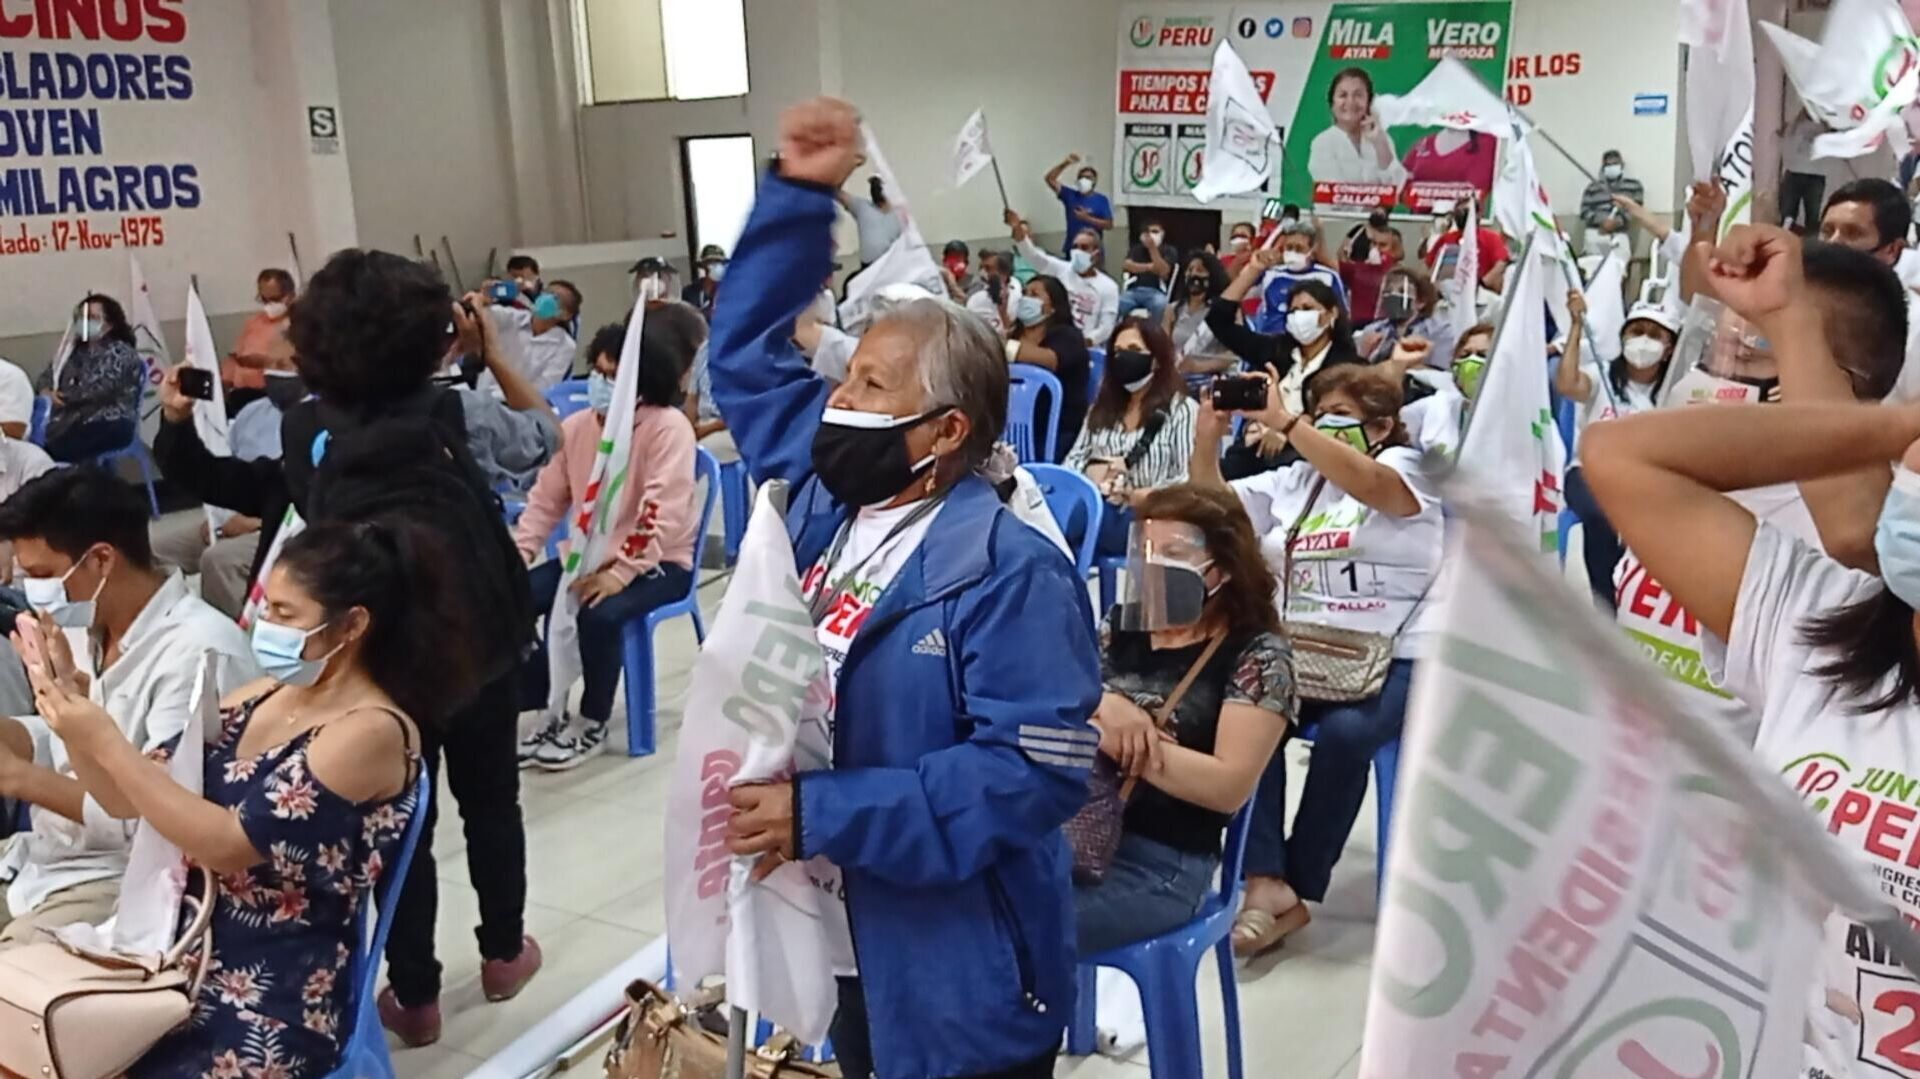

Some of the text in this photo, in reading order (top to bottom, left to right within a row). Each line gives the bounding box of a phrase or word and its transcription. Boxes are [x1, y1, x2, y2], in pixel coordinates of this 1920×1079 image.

[1158, 27, 1214, 47] PERU
[1328, 19, 1394, 45] MILA
[1427, 18, 1501, 45] VERO
[1342, 48, 1377, 59] AYAY
[1534, 53, 1581, 77] LOS
[0, 52, 194, 101] LADORES
[1130, 75, 1198, 92] TIEMPOS
[1129, 95, 1170, 111] PARA
[1173, 96, 1193, 112] EL
[311, 109, 334, 136] S
[0, 164, 201, 217] MILAGROS
[1315, 184, 1332, 194] AL
[1332, 194, 1381, 206] CALLAO
[52, 216, 164, 251] 17-Nov-1975
[1293, 533, 1340, 551] AYAY
[1340, 561, 1358, 592] 1
